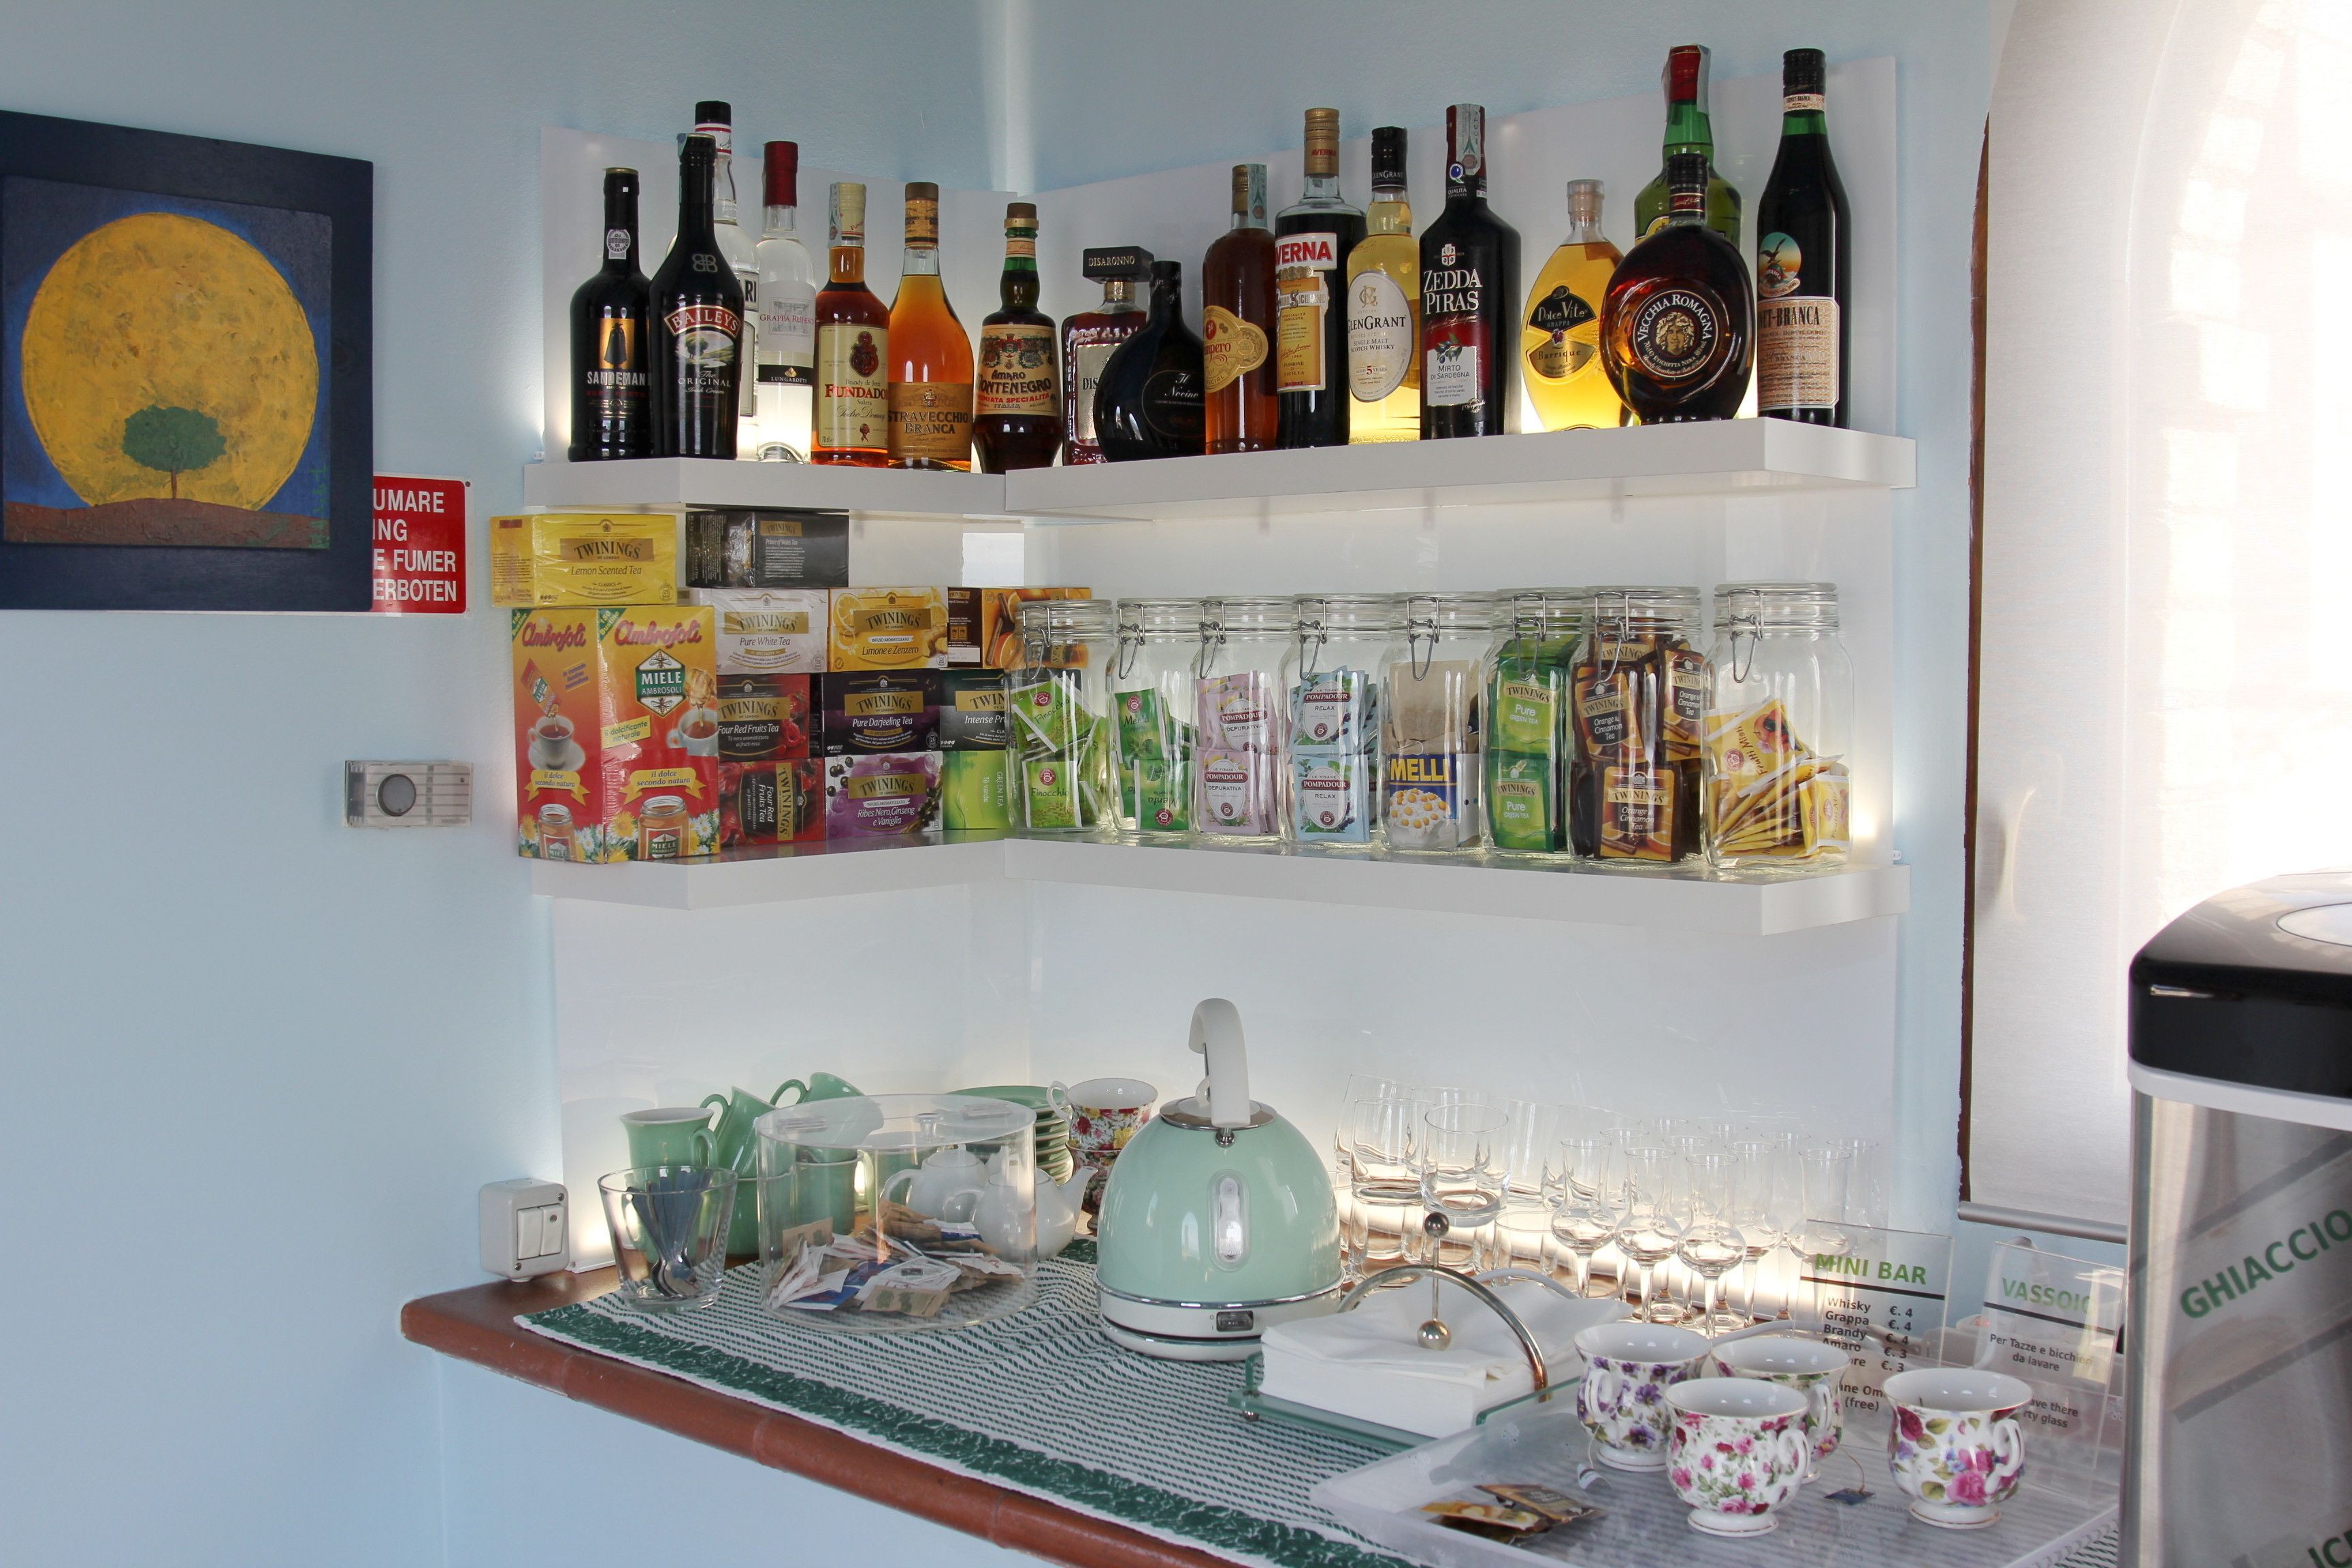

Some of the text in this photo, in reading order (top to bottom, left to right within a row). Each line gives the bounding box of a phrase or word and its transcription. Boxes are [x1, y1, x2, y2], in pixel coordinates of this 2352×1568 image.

[1088, 255, 1135, 267] DISARONNO
[1423, 268, 1483, 293] ZEDDA
[1425, 291, 1480, 315] PIRAS
[1539, 300, 1585, 321] Dolce Vite
[672, 310, 737, 331] BAILEYS
[1348, 314, 1406, 333] GLENGRANT
[1637, 294, 1712, 342] VECCHIA ROMAGNA
[1539, 350, 1581, 362] Barrique
[992, 369, 1026, 381] AMARO
[1367, 365, 1373, 375] 5
[587, 371, 645, 386] SANDEMAN
[678, 377, 731, 387] ORIGINAL
[888, 411, 969, 423] STRAVECCHIO
[905, 423, 956, 434] BRANCA
[372, 488, 444, 513] UMARE
[767, 522, 796, 534] TWININGS
[574, 541, 640, 559] TWININGS
[393, 549, 456, 572] FUMER
[571, 566, 642, 576] Lemon Scented Tea
[373, 578, 457, 602] ERBOTEN
[737, 614, 796, 632] TWININGS
[866, 611, 920, 630] TWININGS
[740, 636, 791, 647] Pure White Tea
[862, 646, 887, 655] Limone
[893, 645, 919, 654] Zenzero
[642, 671, 682, 685] MIELE
[642, 686, 682, 695] AMBROSOLI
[1506, 687, 1551, 703] TWININGS
[1679, 690, 1697, 700] Orange
[719, 701, 778, 719] TWININGS
[856, 694, 913, 713] TWININGS
[1515, 704, 1536, 717] Pure
[1584, 700, 1623, 715] TWININGS
[1034, 698, 1071, 724] Finocchio
[1222, 711, 1264, 721] POMPADOUR
[852, 716, 913, 727] Pure Darjeeling Tea
[964, 715, 994, 724] Intense
[1124, 715, 1150, 727] Menta
[1594, 716, 1614, 726] Orange
[610, 721, 648, 735] dolcificante
[718, 723, 779, 734] Four Red Fruits Tea
[1226, 723, 1264, 732] DEPURATIVA
[1595, 723, 1623, 734] Cinnamon
[613, 730, 640, 742] naturale
[1735, 726, 1769, 776] Frutti Misti
[636, 778, 666, 786] secondo
[860, 777, 915, 796] TWININGS
[1497, 782, 1537, 796] TWININGS
[766, 786, 774, 804] Four
[1030, 787, 1069, 797] Finocchio
[1612, 789, 1665, 804] TWININGS
[778, 770, 791, 835] TWININGS
[1506, 801, 1526, 811] Pure
[858, 809, 875, 817] Ribes
[892, 806, 915, 816] Ginseng
[1622, 806, 1648, 816] Orange
[877, 817, 902, 826] Vaniglia
[1620, 814, 1654, 823] Cinnamon
[1815, 1254, 1927, 1285] MINI BAR
[2180, 1209, 2352, 1320] GHIACCIO
[1827, 1297, 1872, 1313] Whisky
[1906, 1308, 1913, 1318] 4
[1825, 1311, 1869, 1326] Grappa
[1904, 1322, 1912, 1332] 4
[1824, 1324, 1867, 1340] Brandy
[1901, 1336, 1910, 1345] 4
[1823, 1338, 1861, 1352] Amaro
[1899, 1350, 1907, 1359] 3
[1990, 1333, 2093, 1366] Per Tazze e bicchieri
[1897, 1363, 1904, 1372] 3
[2012, 1352, 2060, 1371] da lavare
[1844, 1396, 1880, 1411] (free)
[2050, 1401, 2079, 1418] there
[2041, 1413, 2069, 1428] glass
